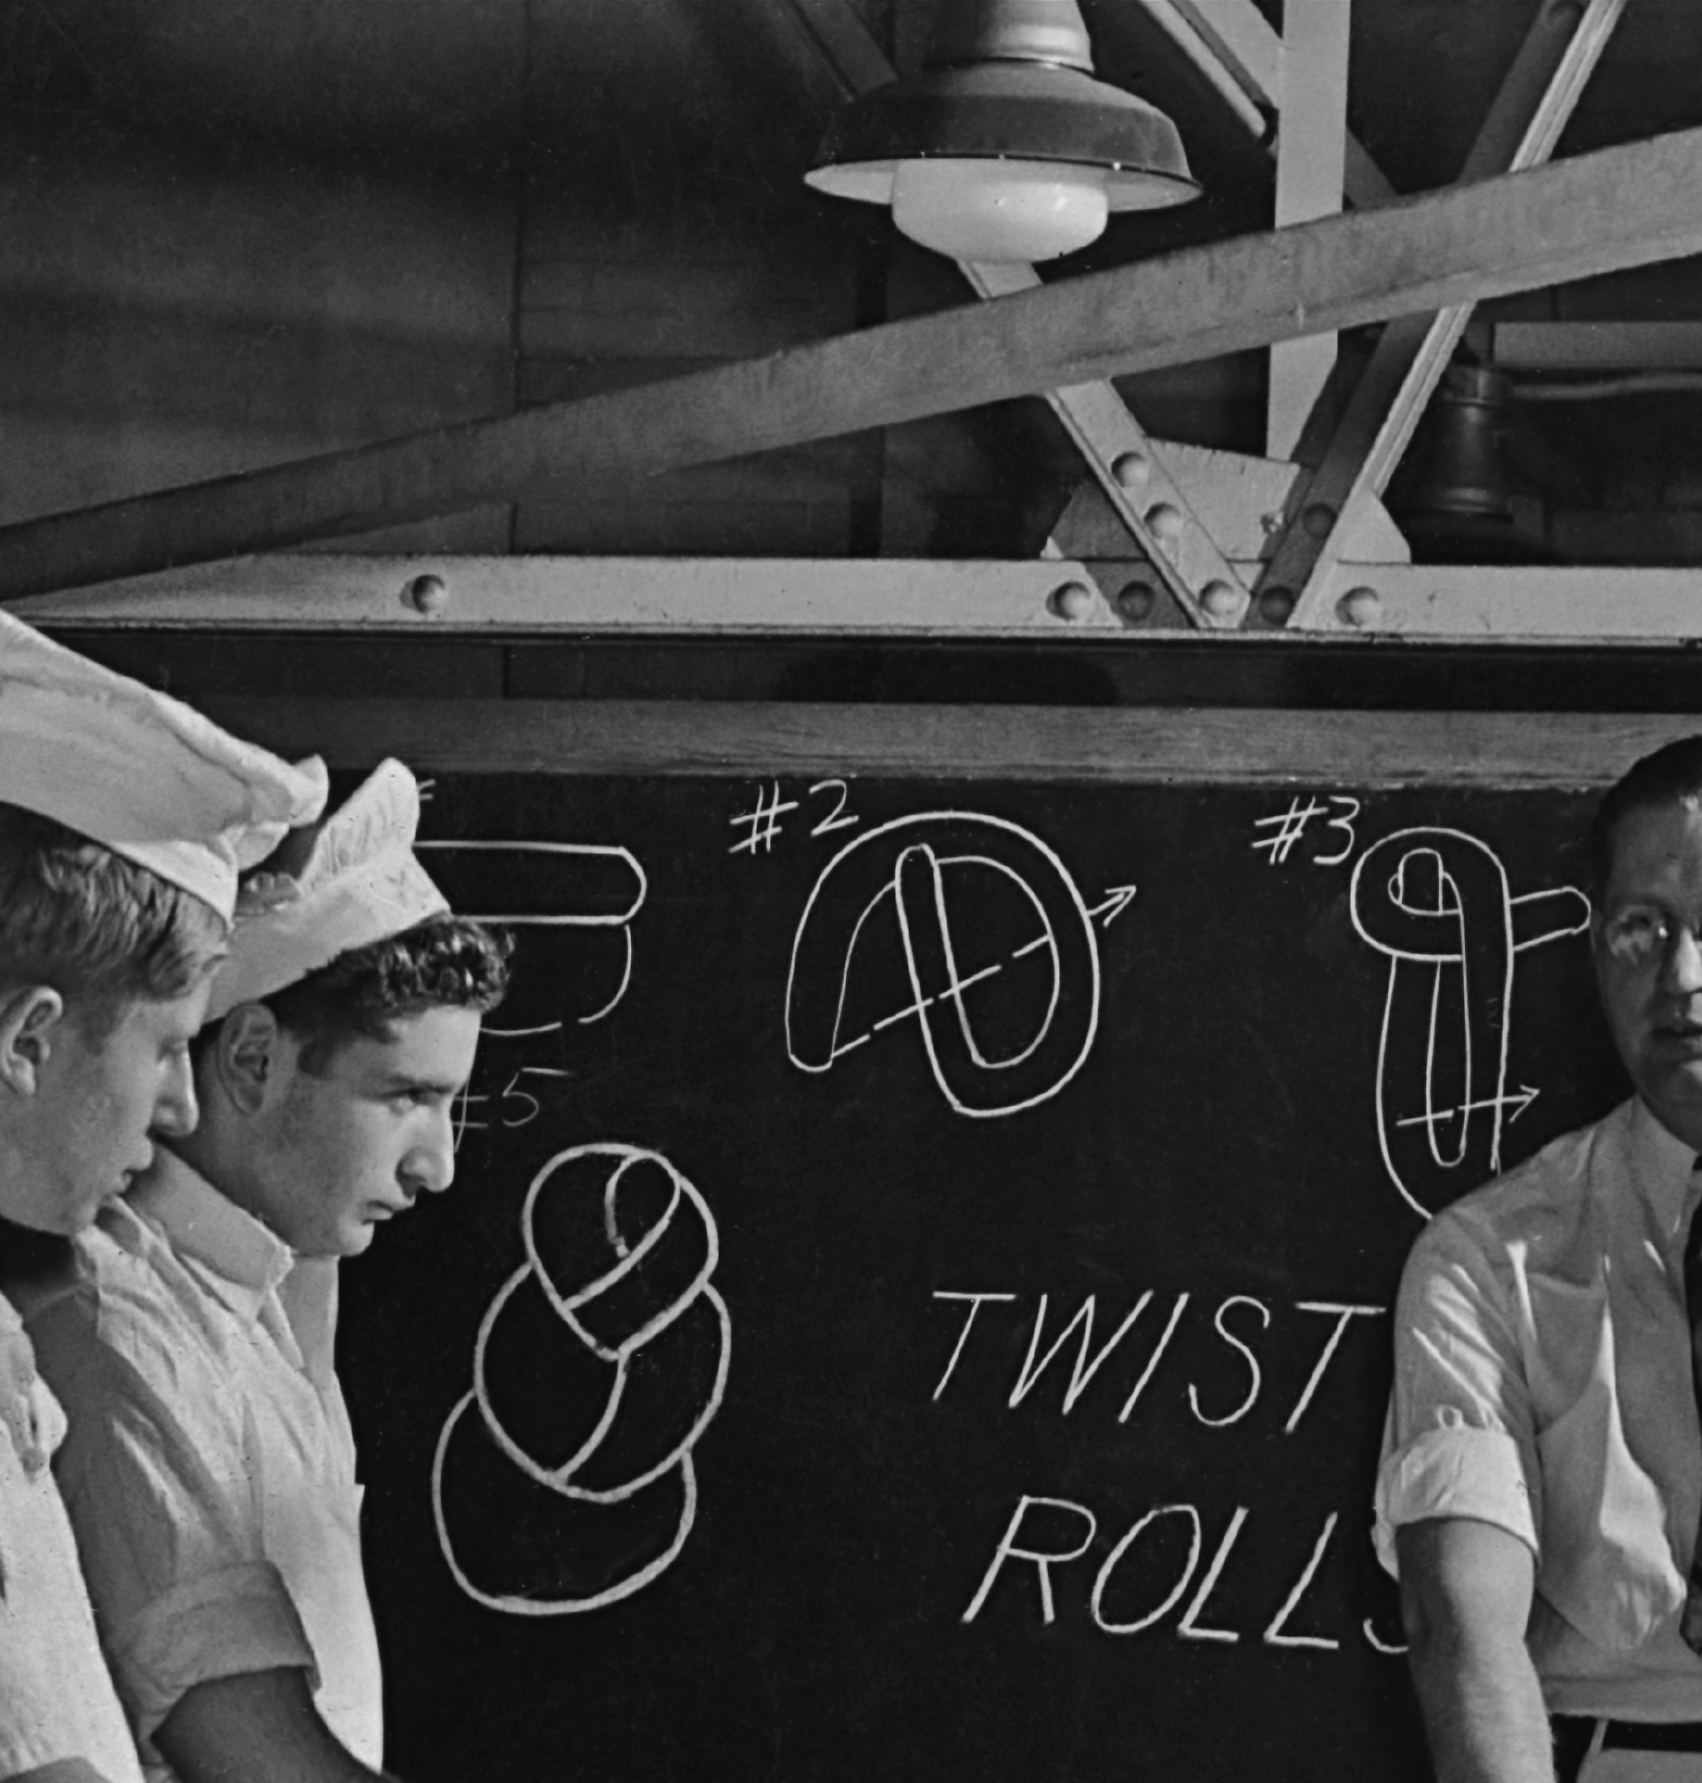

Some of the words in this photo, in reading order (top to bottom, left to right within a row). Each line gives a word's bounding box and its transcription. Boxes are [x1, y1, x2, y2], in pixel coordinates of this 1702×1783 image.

[729, 780, 860, 855] #2
[1251, 796, 1360, 866] #3
[932, 1289, 1386, 1433] TWIST
